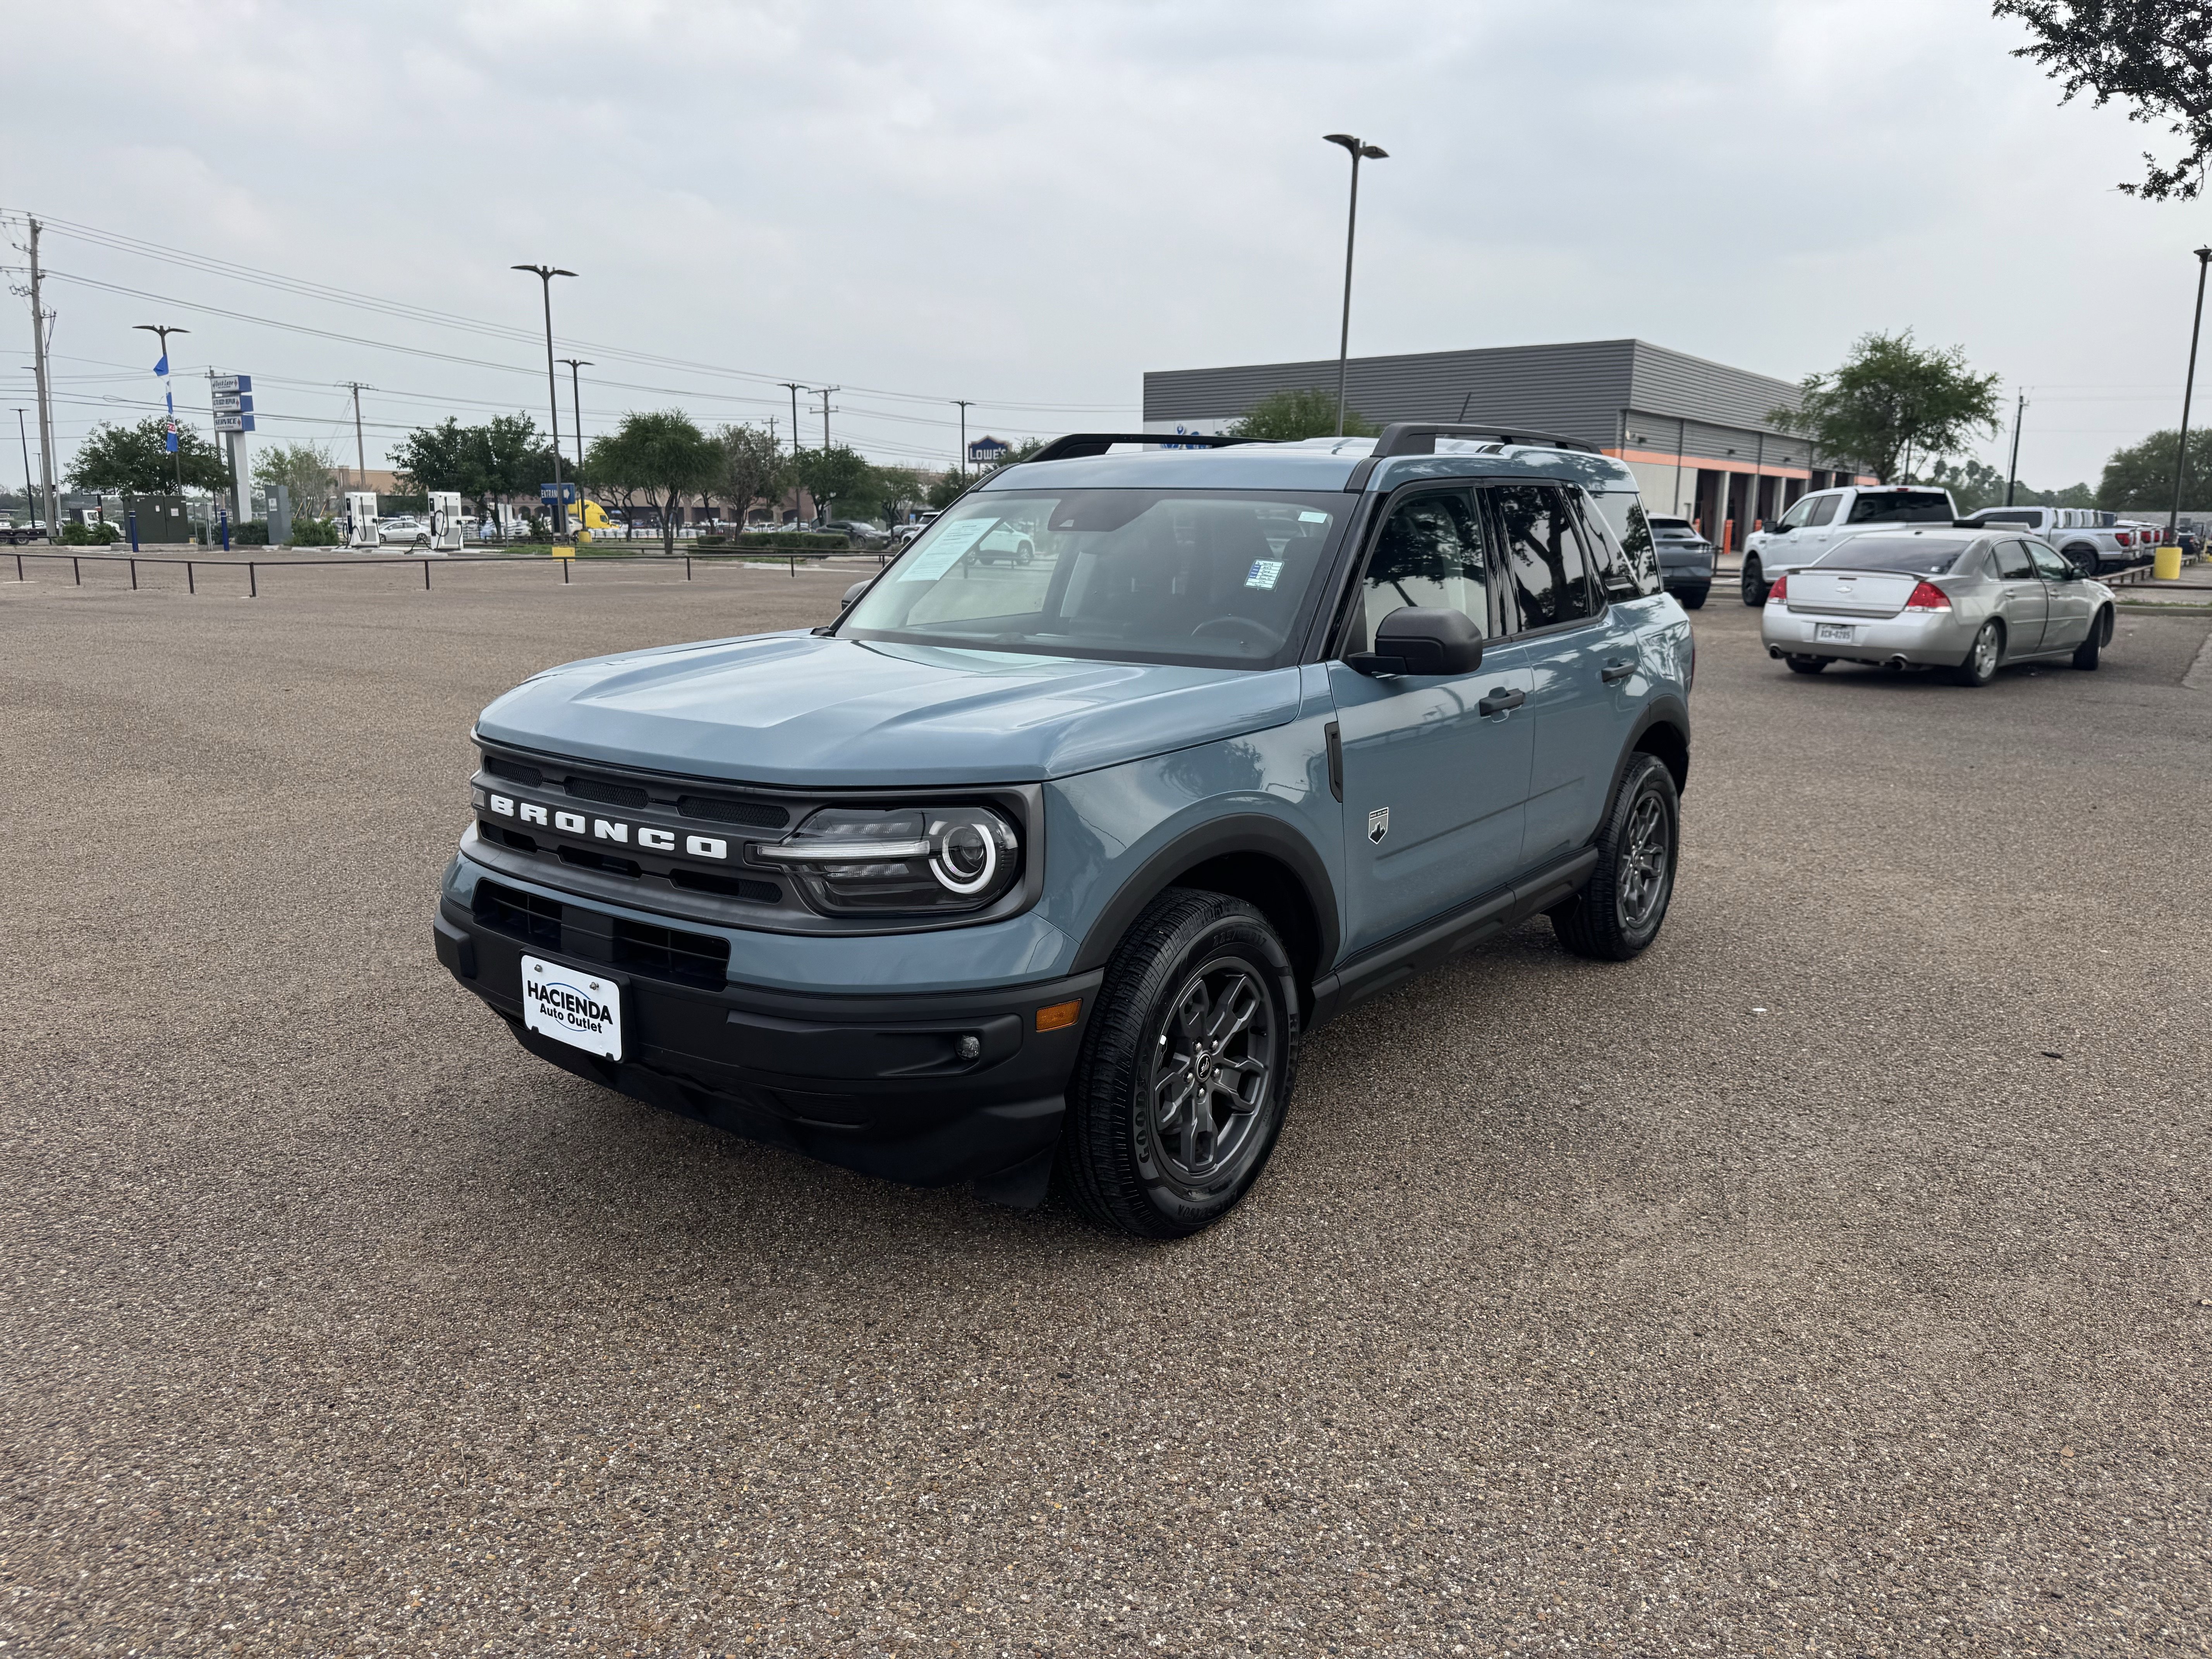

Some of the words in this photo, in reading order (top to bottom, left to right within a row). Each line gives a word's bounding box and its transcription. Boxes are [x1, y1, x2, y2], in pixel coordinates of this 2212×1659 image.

[970, 447, 1006, 460] LOWE'S
[490, 794, 727, 859] BRONCO
[527, 980, 613, 1025] HACIENDA
[540, 1003, 564, 1020] Auto
[567, 1013, 602, 1034] Outlet
